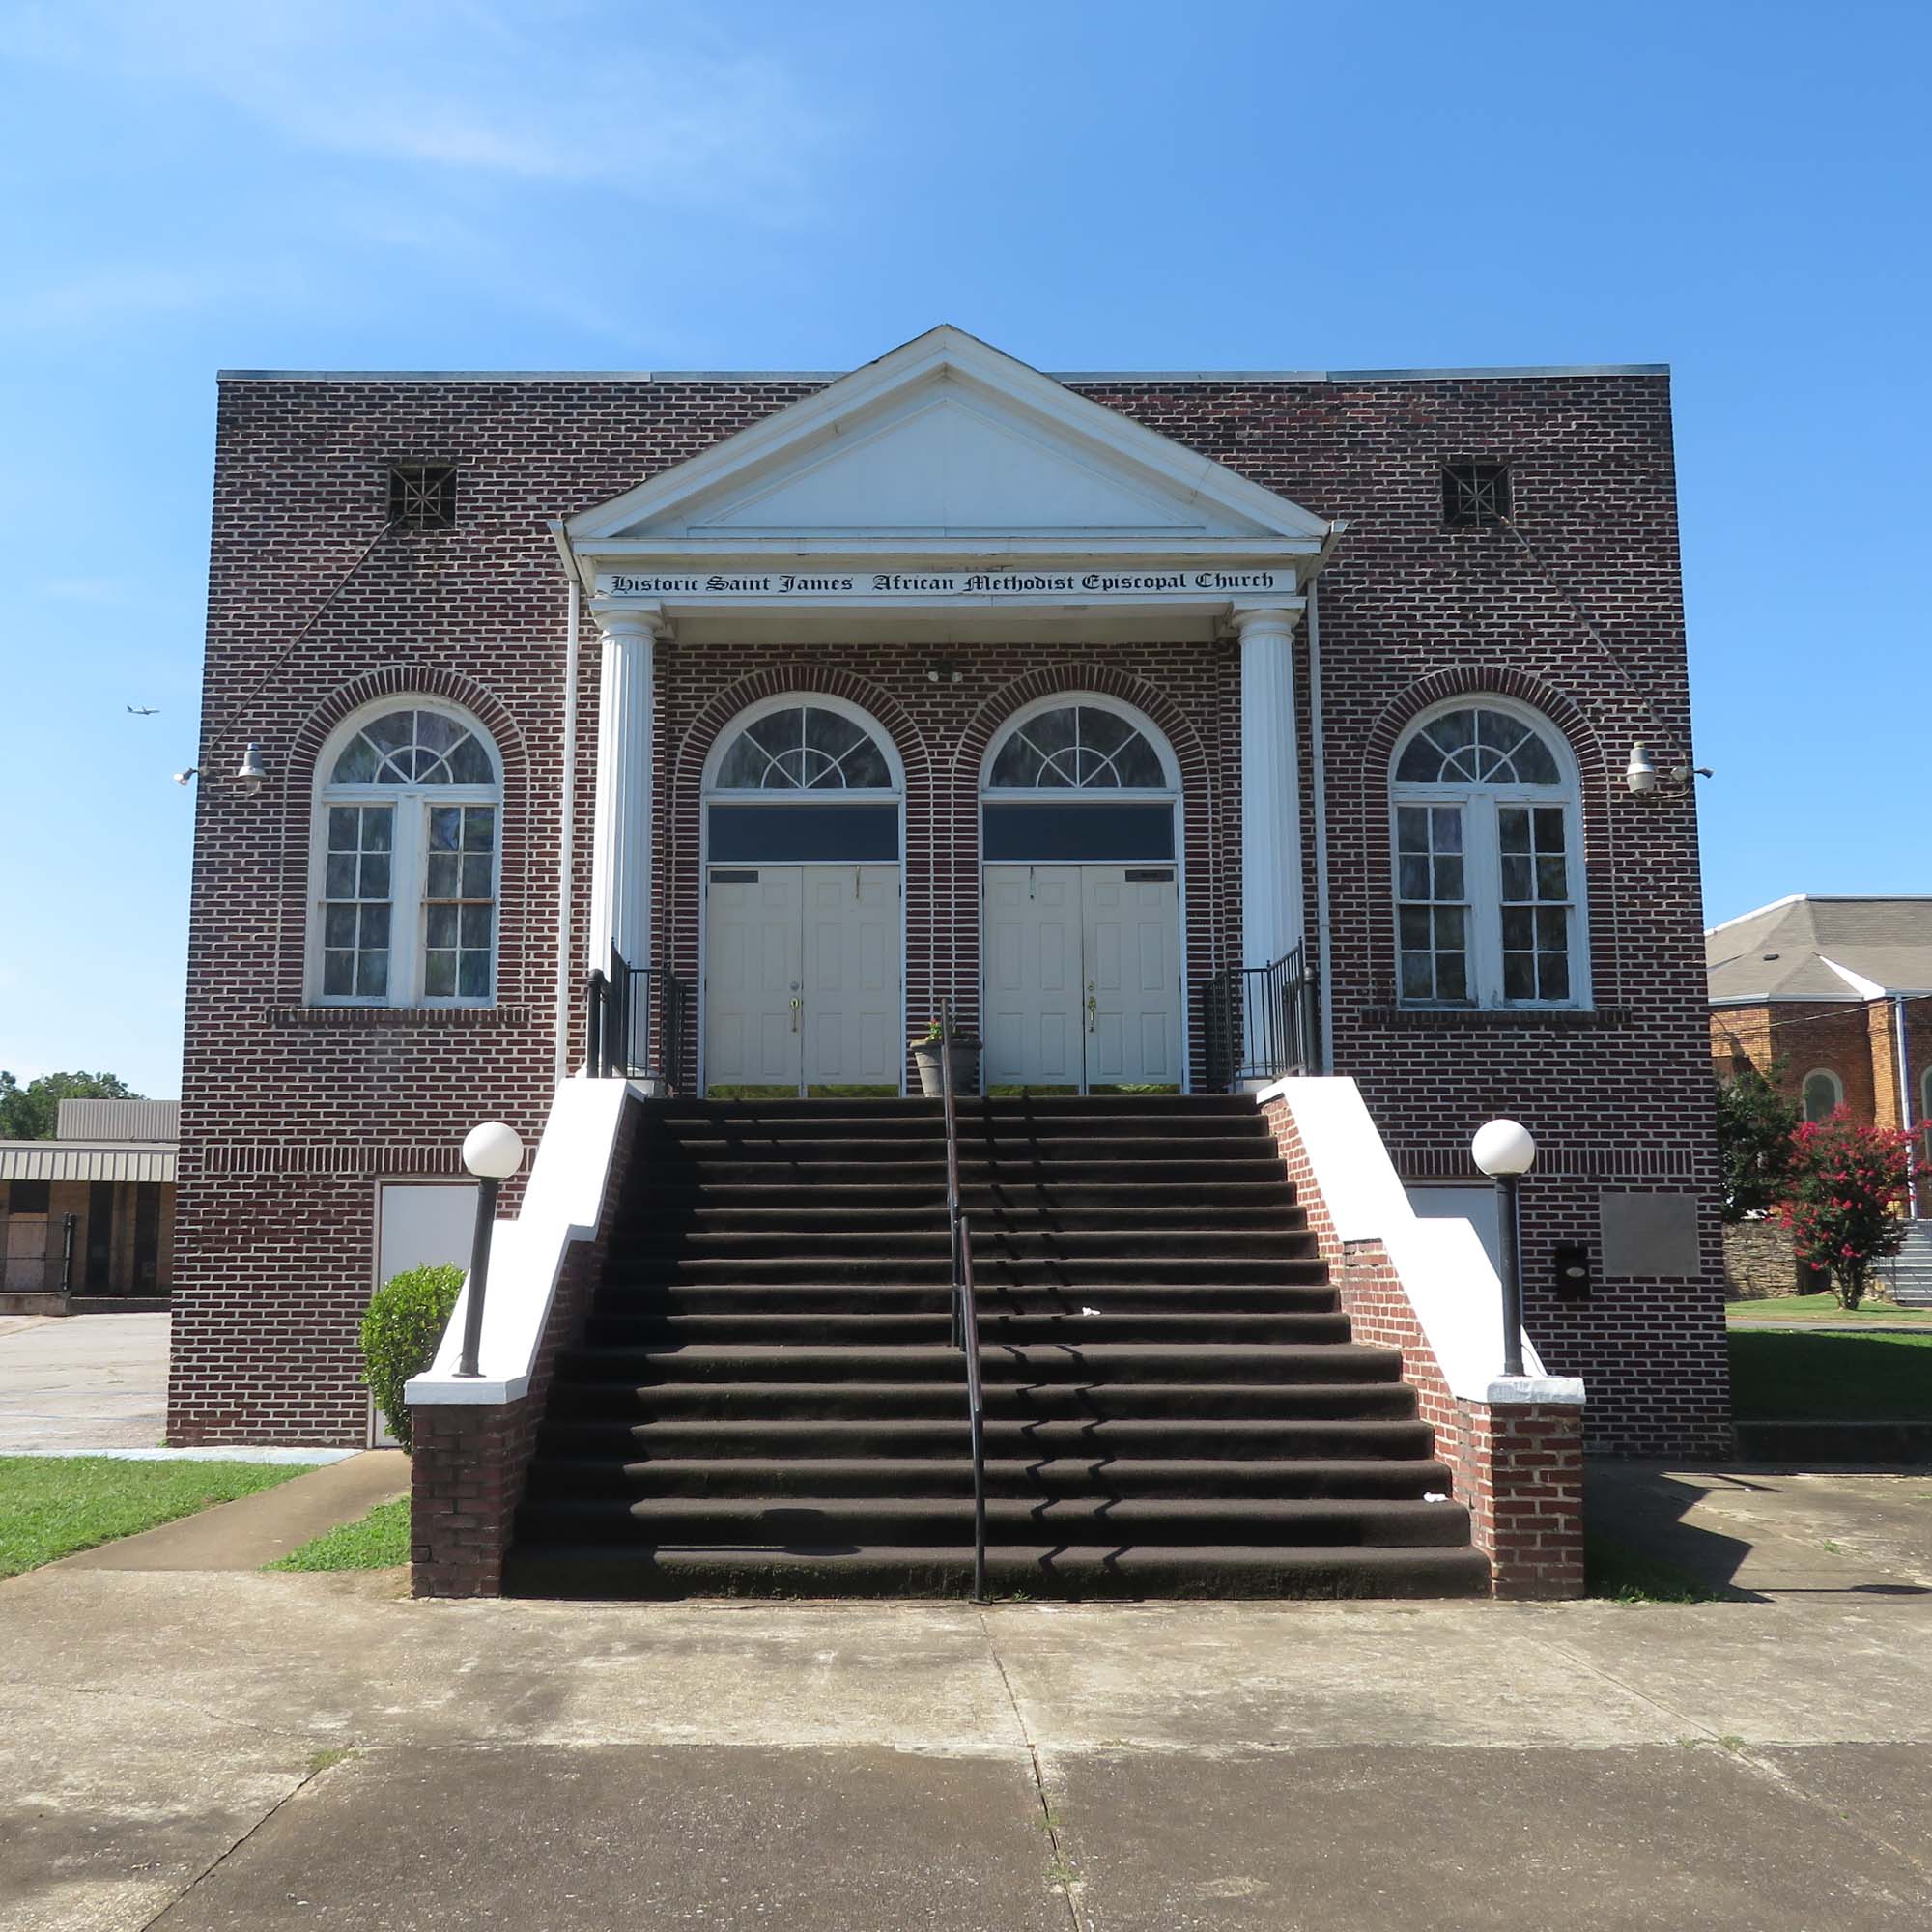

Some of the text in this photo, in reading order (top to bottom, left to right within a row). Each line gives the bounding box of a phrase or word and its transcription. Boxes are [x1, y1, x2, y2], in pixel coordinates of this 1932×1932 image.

[611, 571, 1274, 594] Historic Saint James African Methodist Episcopal Church
